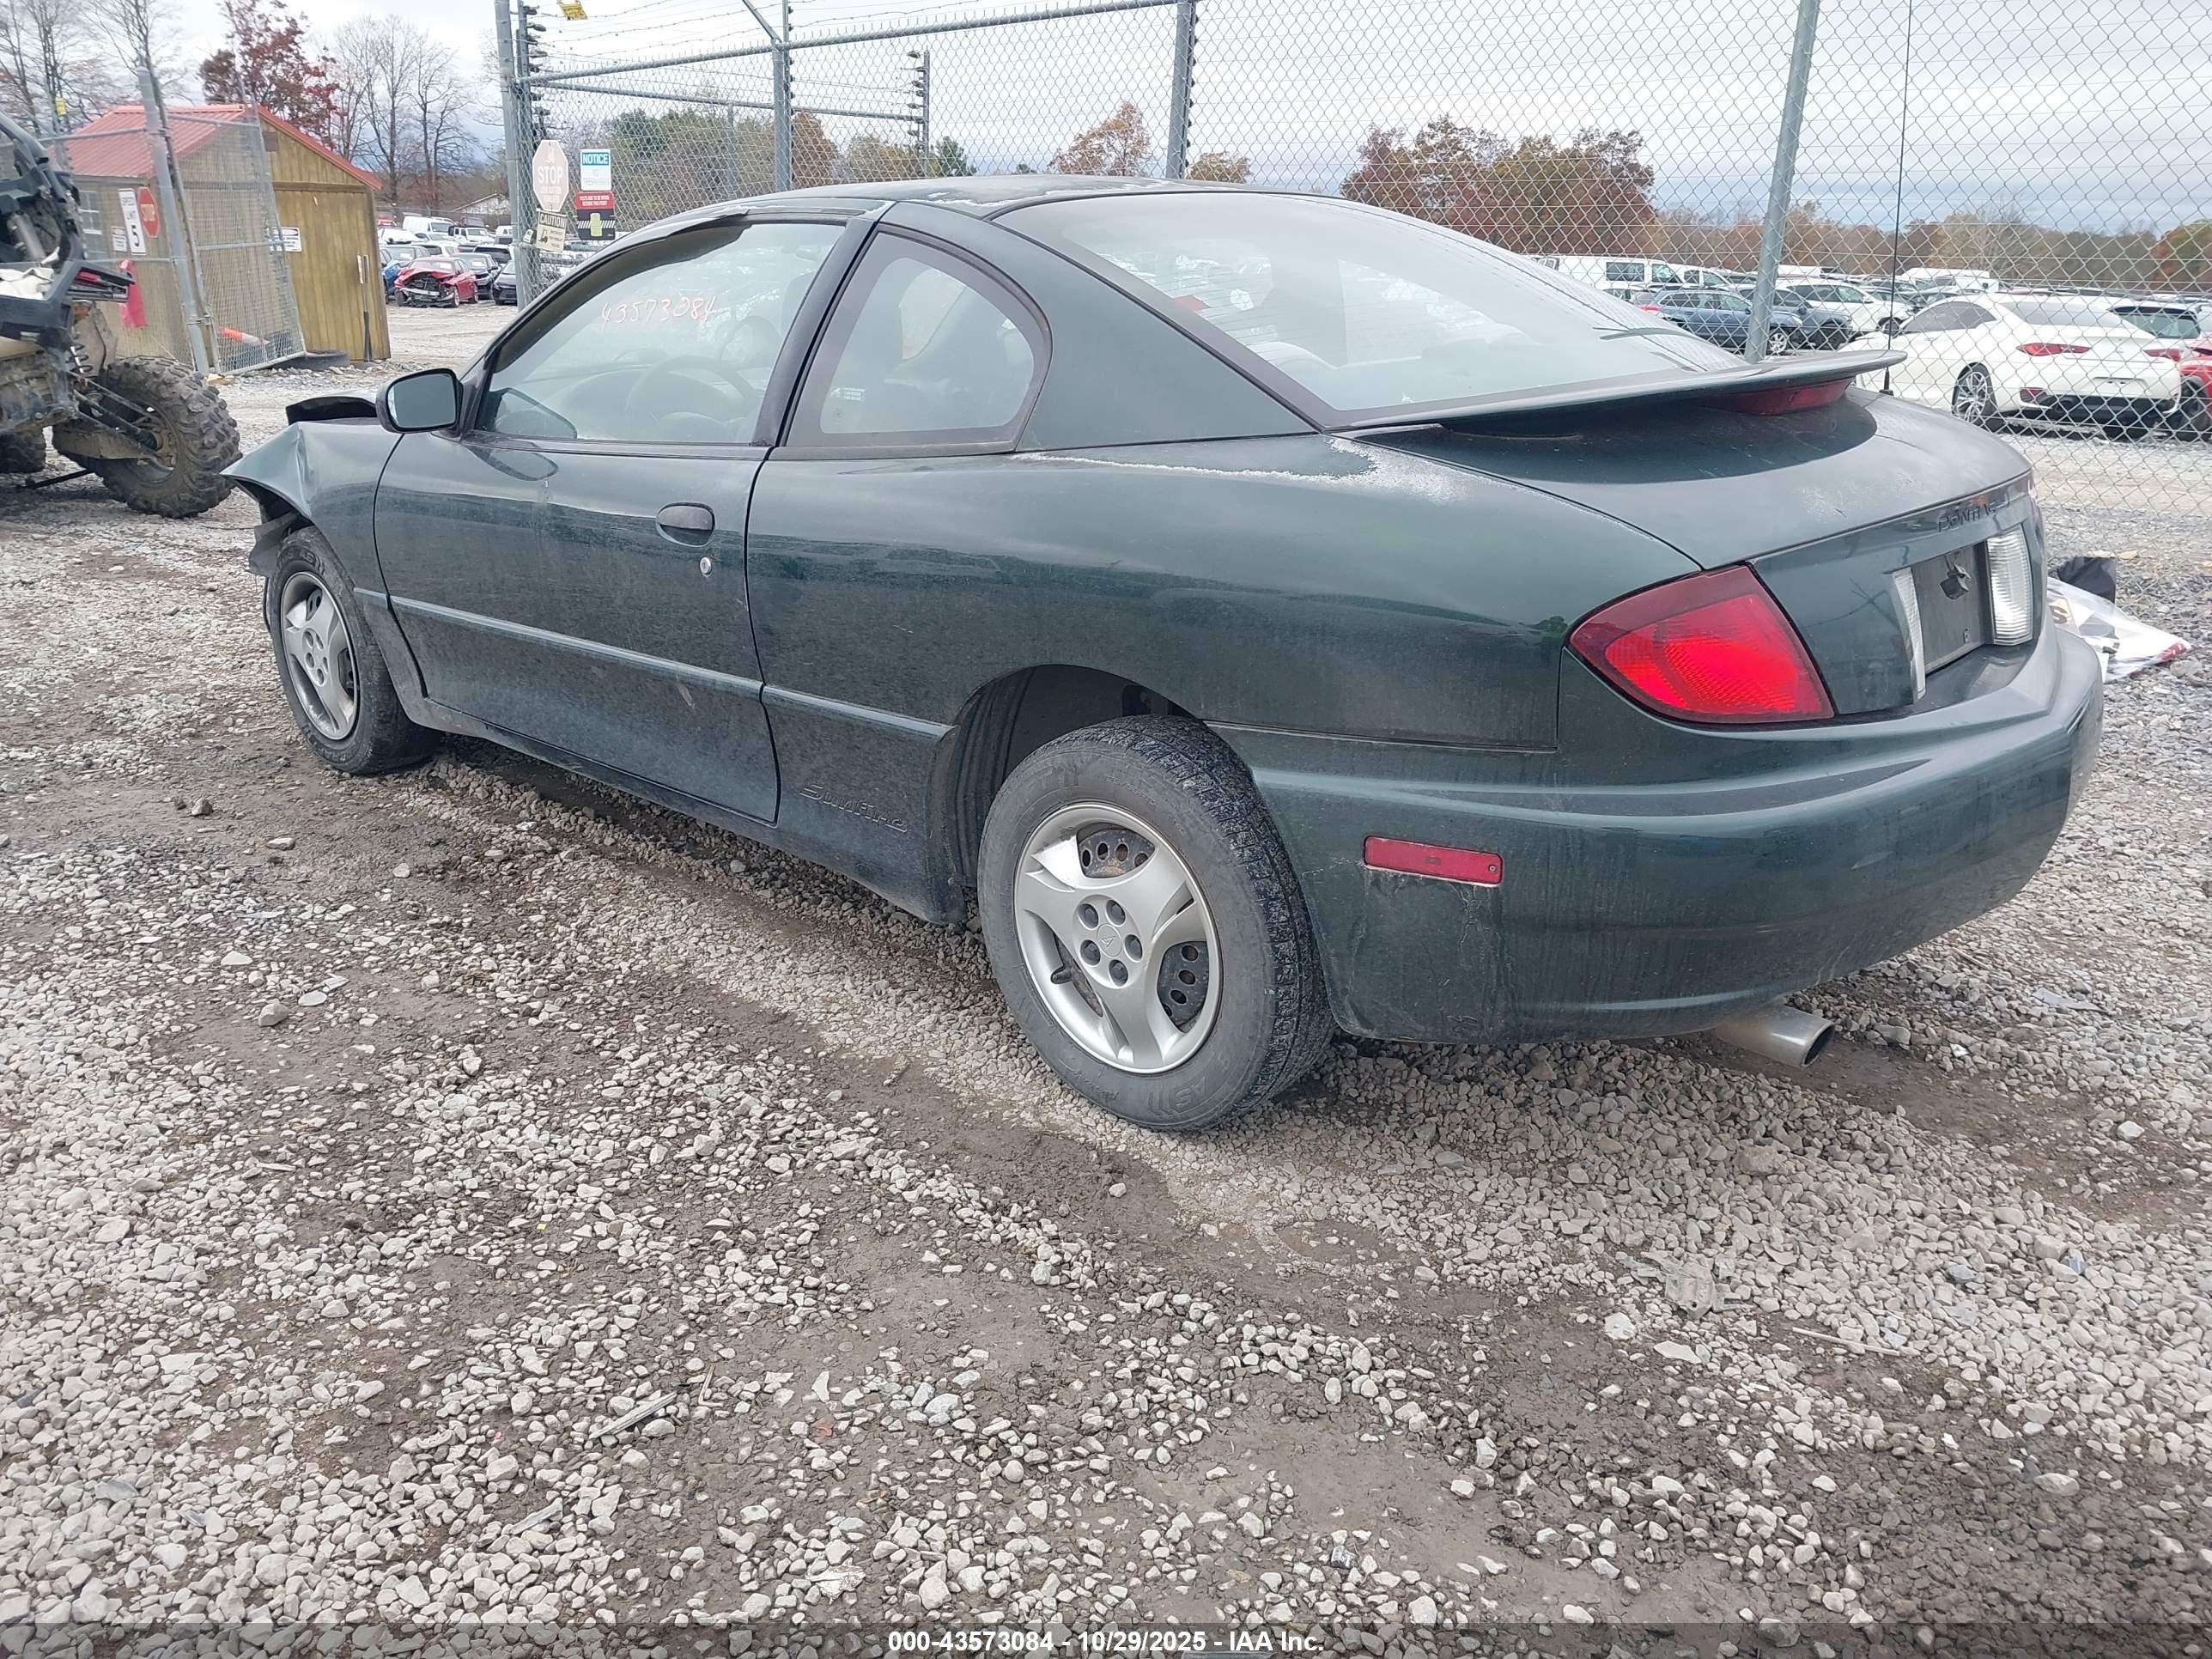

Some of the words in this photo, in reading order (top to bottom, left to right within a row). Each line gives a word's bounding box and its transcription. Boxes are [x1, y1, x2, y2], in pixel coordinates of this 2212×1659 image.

[582, 153, 609, 165] NOTICE
[538, 165, 563, 185] STOP
[539, 212, 566, 228] CAUTION
[130, 224, 140, 247] 5
[601, 295, 718, 330] 43573084
